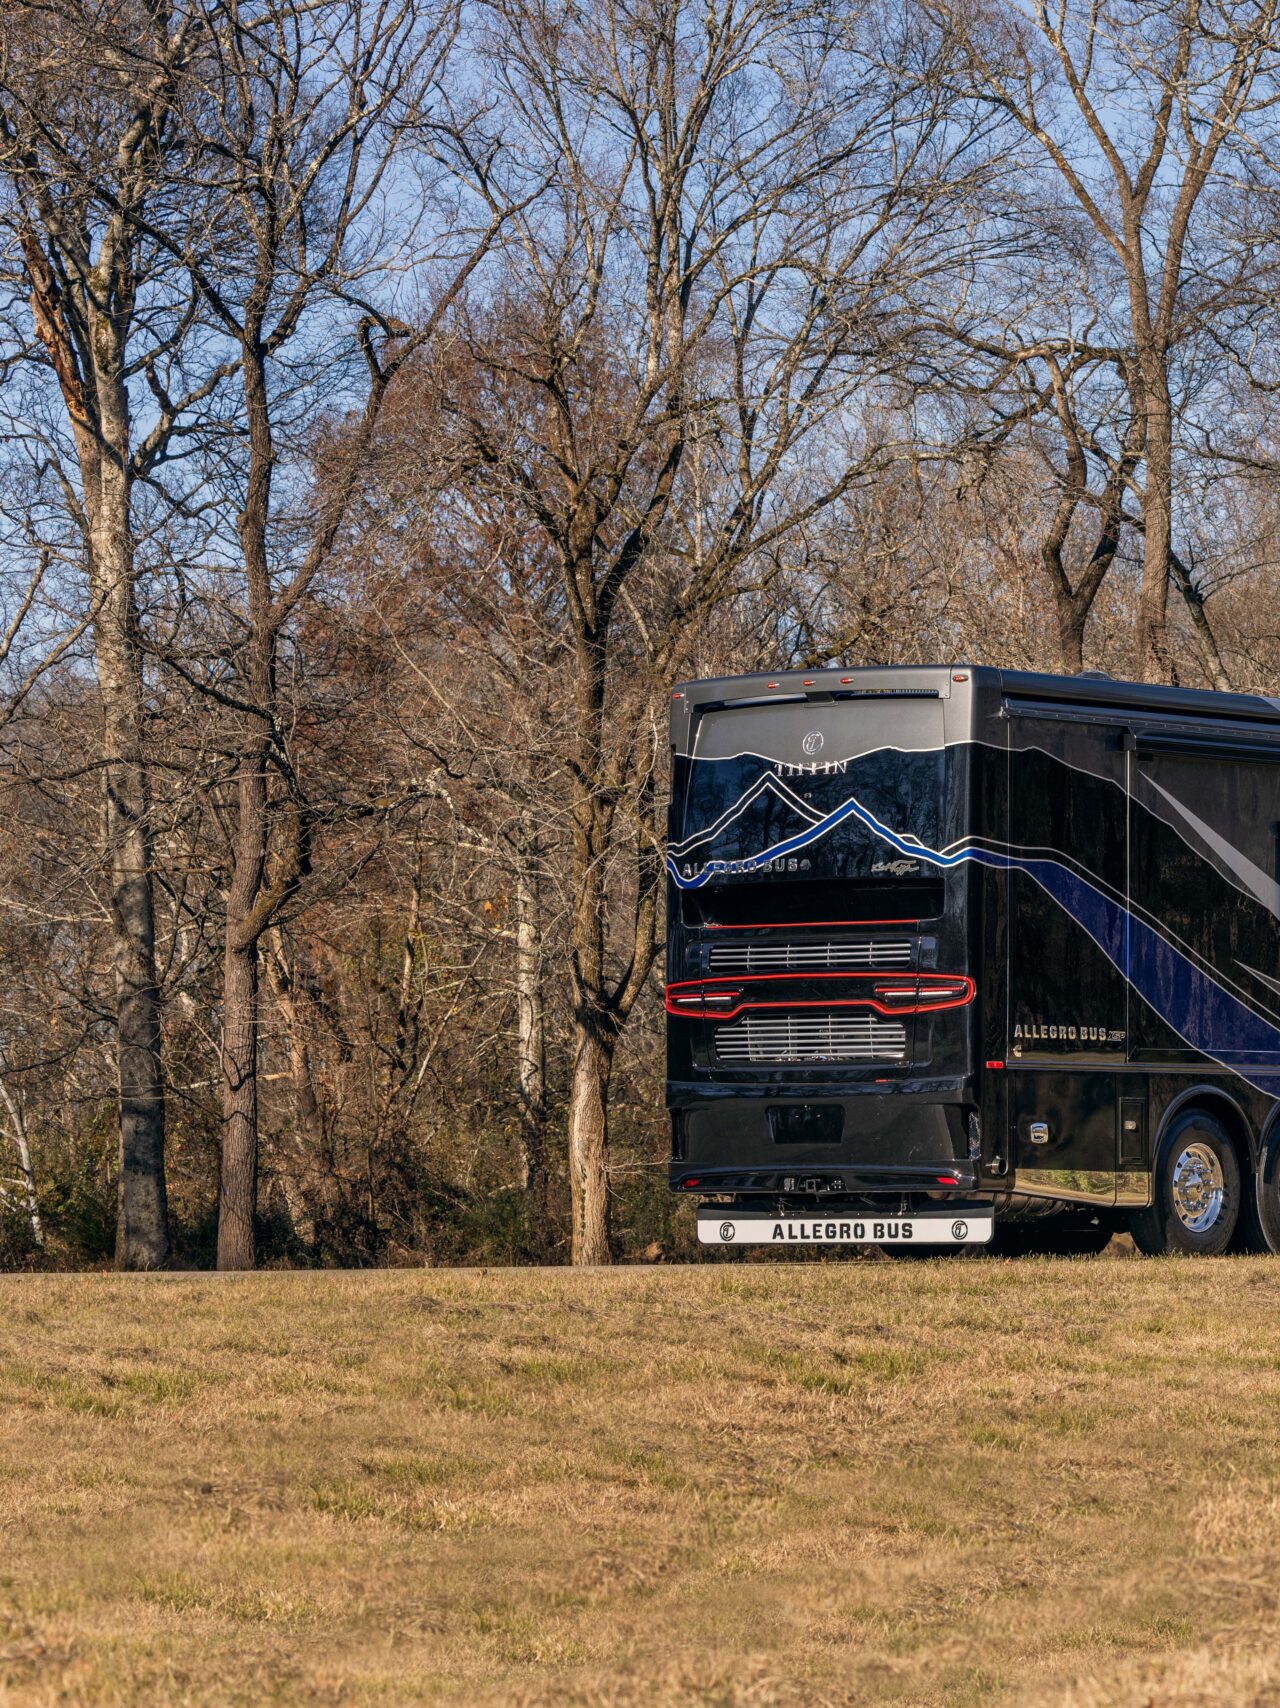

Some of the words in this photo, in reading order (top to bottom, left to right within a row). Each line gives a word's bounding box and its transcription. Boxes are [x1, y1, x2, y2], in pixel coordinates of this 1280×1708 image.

[774, 760, 847, 777] TIFFIN
[682, 860, 757, 877] ALLEGRO
[762, 858, 798, 873] BUS
[1014, 1024, 1077, 1040] ALLEGRO
[1080, 1026, 1107, 1041] BUS
[772, 1223, 865, 1240] ALLEGRO
[873, 1222, 913, 1239] BUS
